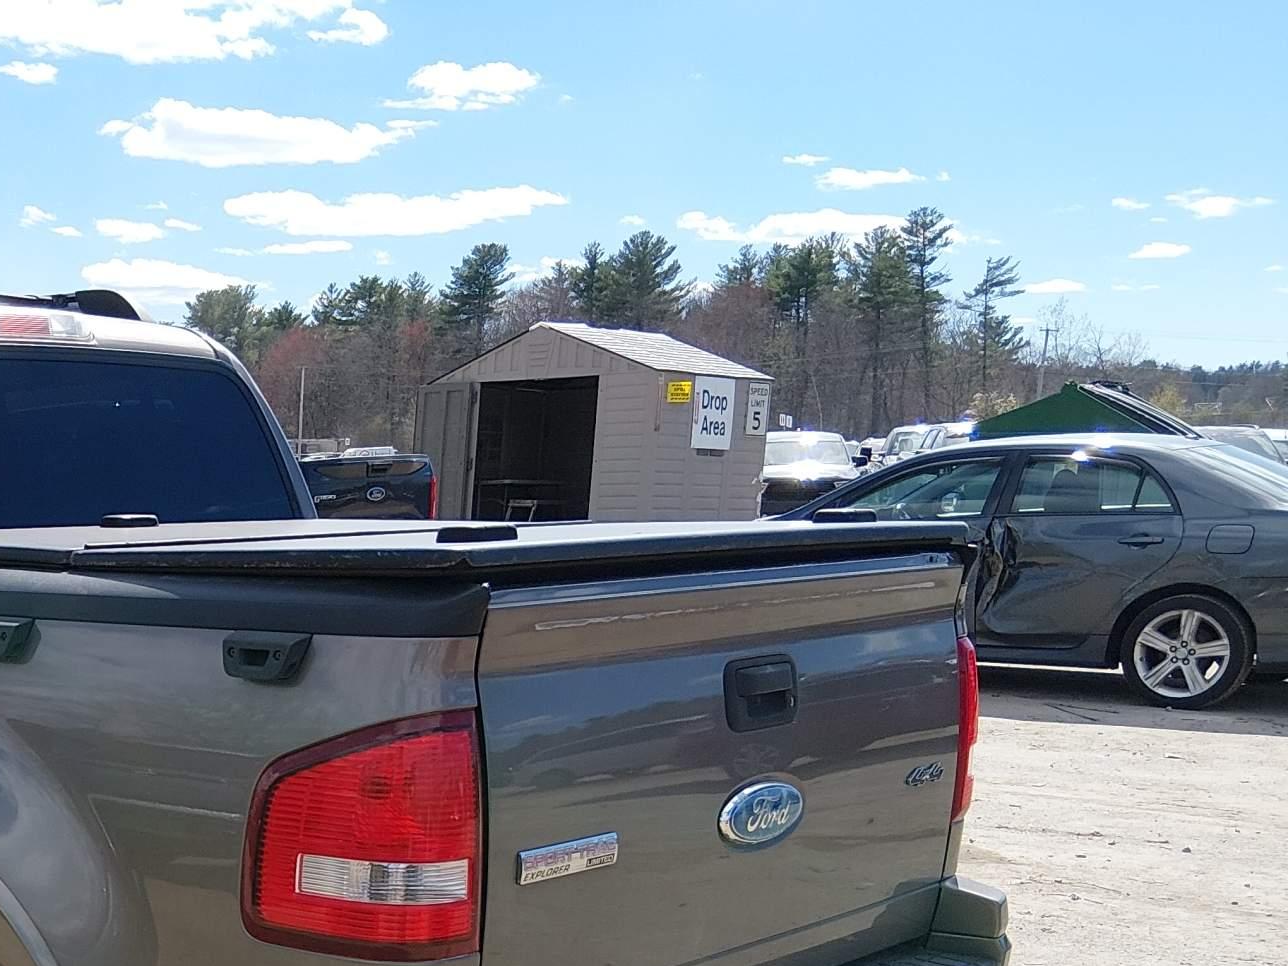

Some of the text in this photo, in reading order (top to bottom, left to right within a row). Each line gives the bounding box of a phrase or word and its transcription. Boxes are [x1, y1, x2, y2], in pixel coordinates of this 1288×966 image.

[750, 387, 769, 397] SPEED
[701, 389, 728, 415] Drop
[750, 399, 766, 408] LIMIT
[700, 415, 726, 436] Area
[752, 411, 761, 430] 5
[747, 796, 791, 832] Ford
[524, 847, 575, 872] SPORT
[586, 854, 615, 866] LIMITED
[523, 864, 571, 882] EXPLORER
